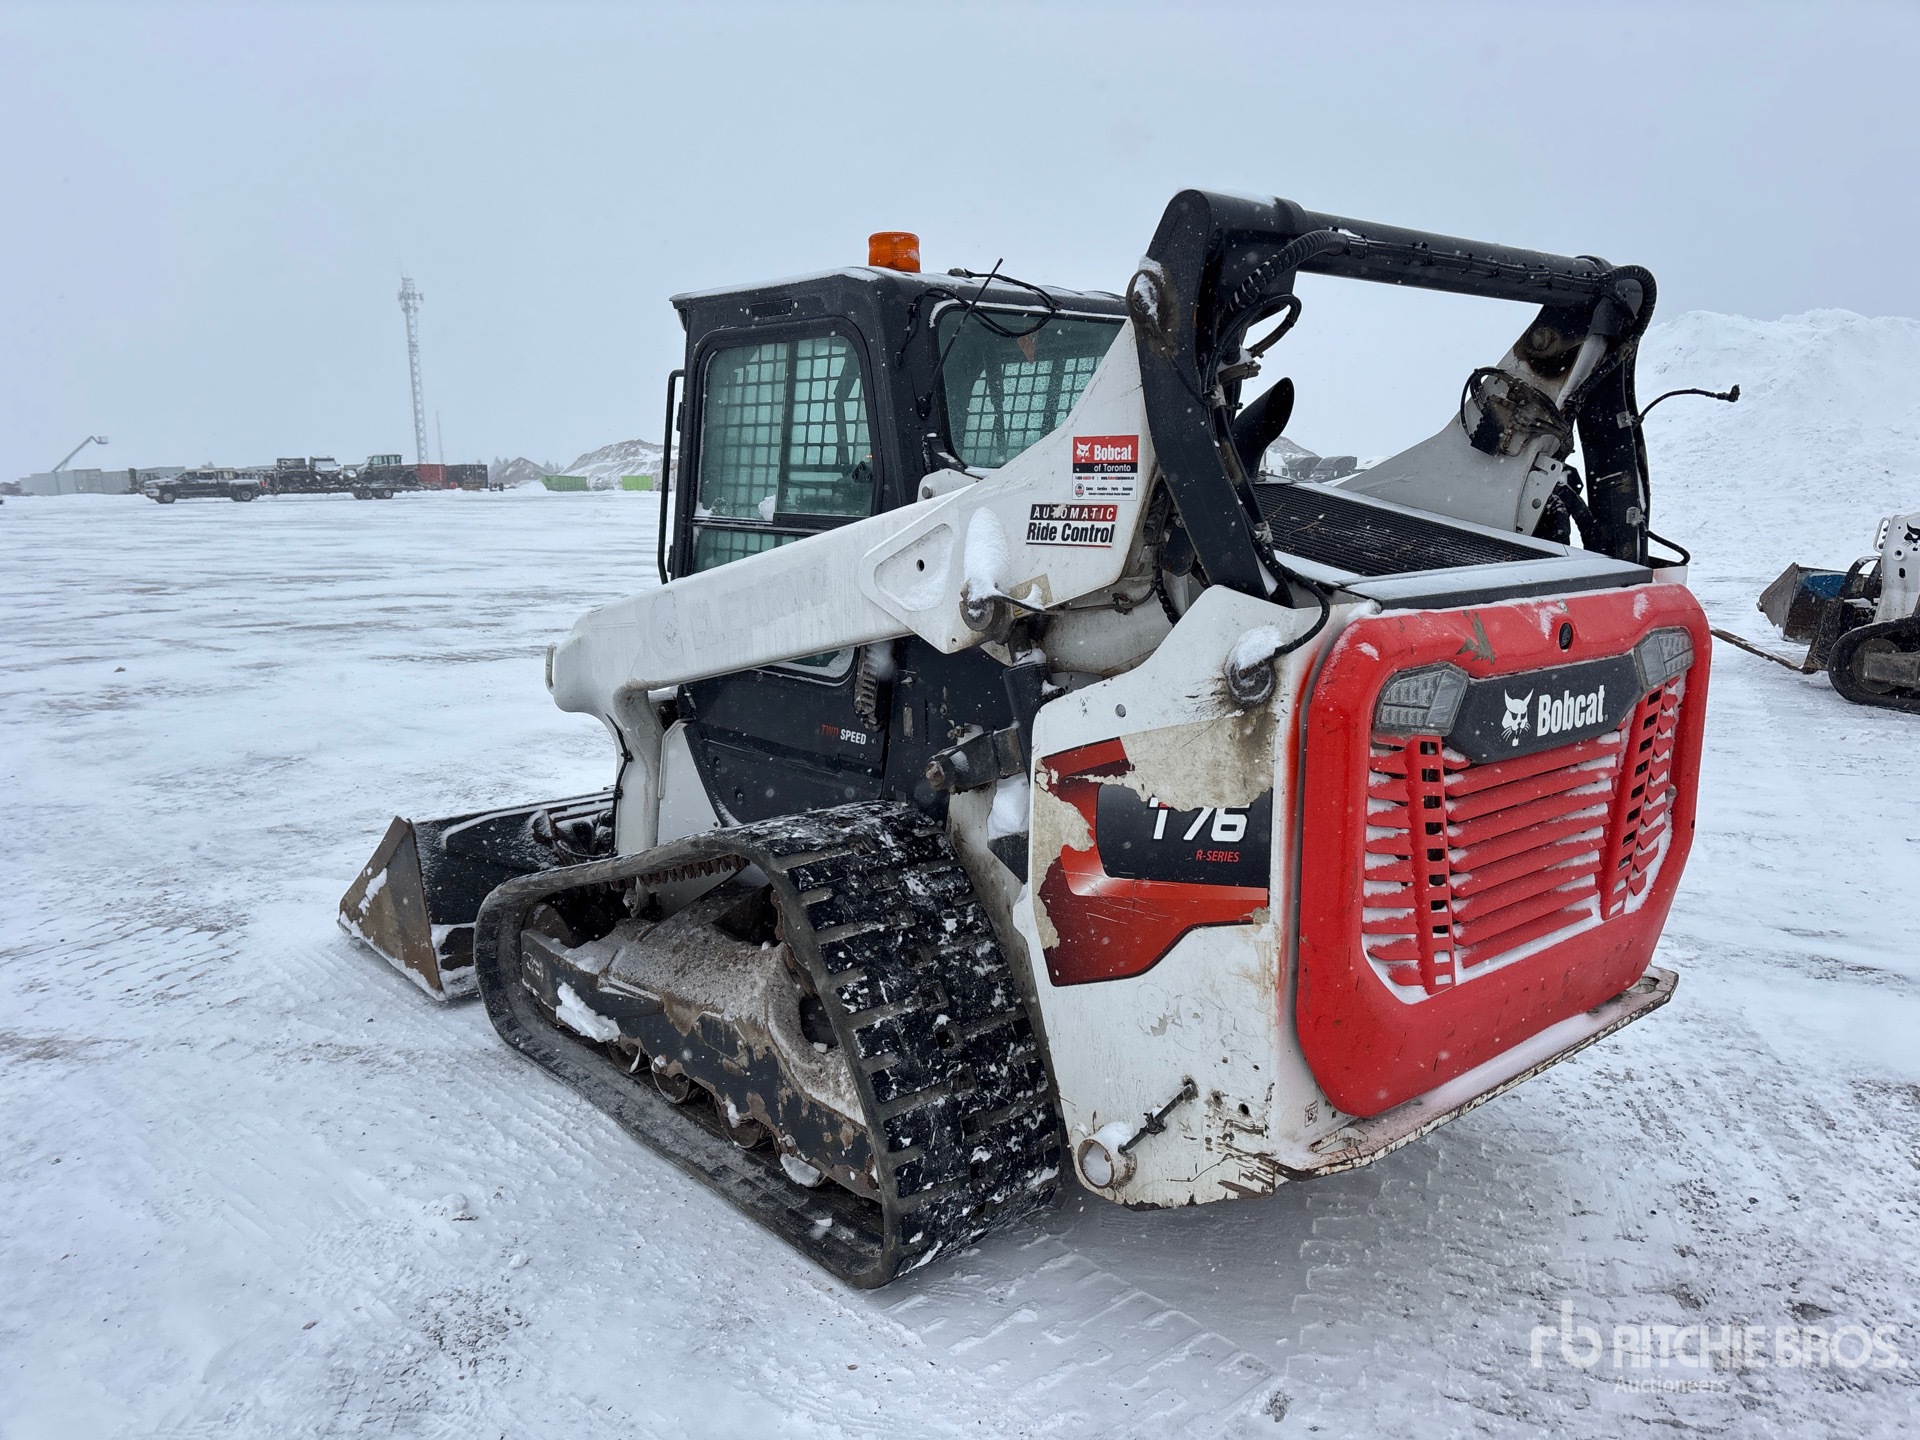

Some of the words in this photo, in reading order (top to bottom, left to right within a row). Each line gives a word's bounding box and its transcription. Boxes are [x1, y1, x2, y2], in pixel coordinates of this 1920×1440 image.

[1093, 444, 1132, 461] Bobcat
[1093, 464, 1102, 472] of
[1103, 464, 1131, 472] Toronto
[1026, 521, 1058, 541] Ride
[1061, 522, 1116, 544] Control
[1536, 684, 1606, 738] Bobcat
[821, 724, 840, 736] TWO
[840, 728, 867, 746] SPEED
[1195, 849, 1240, 863] R-SERIES
